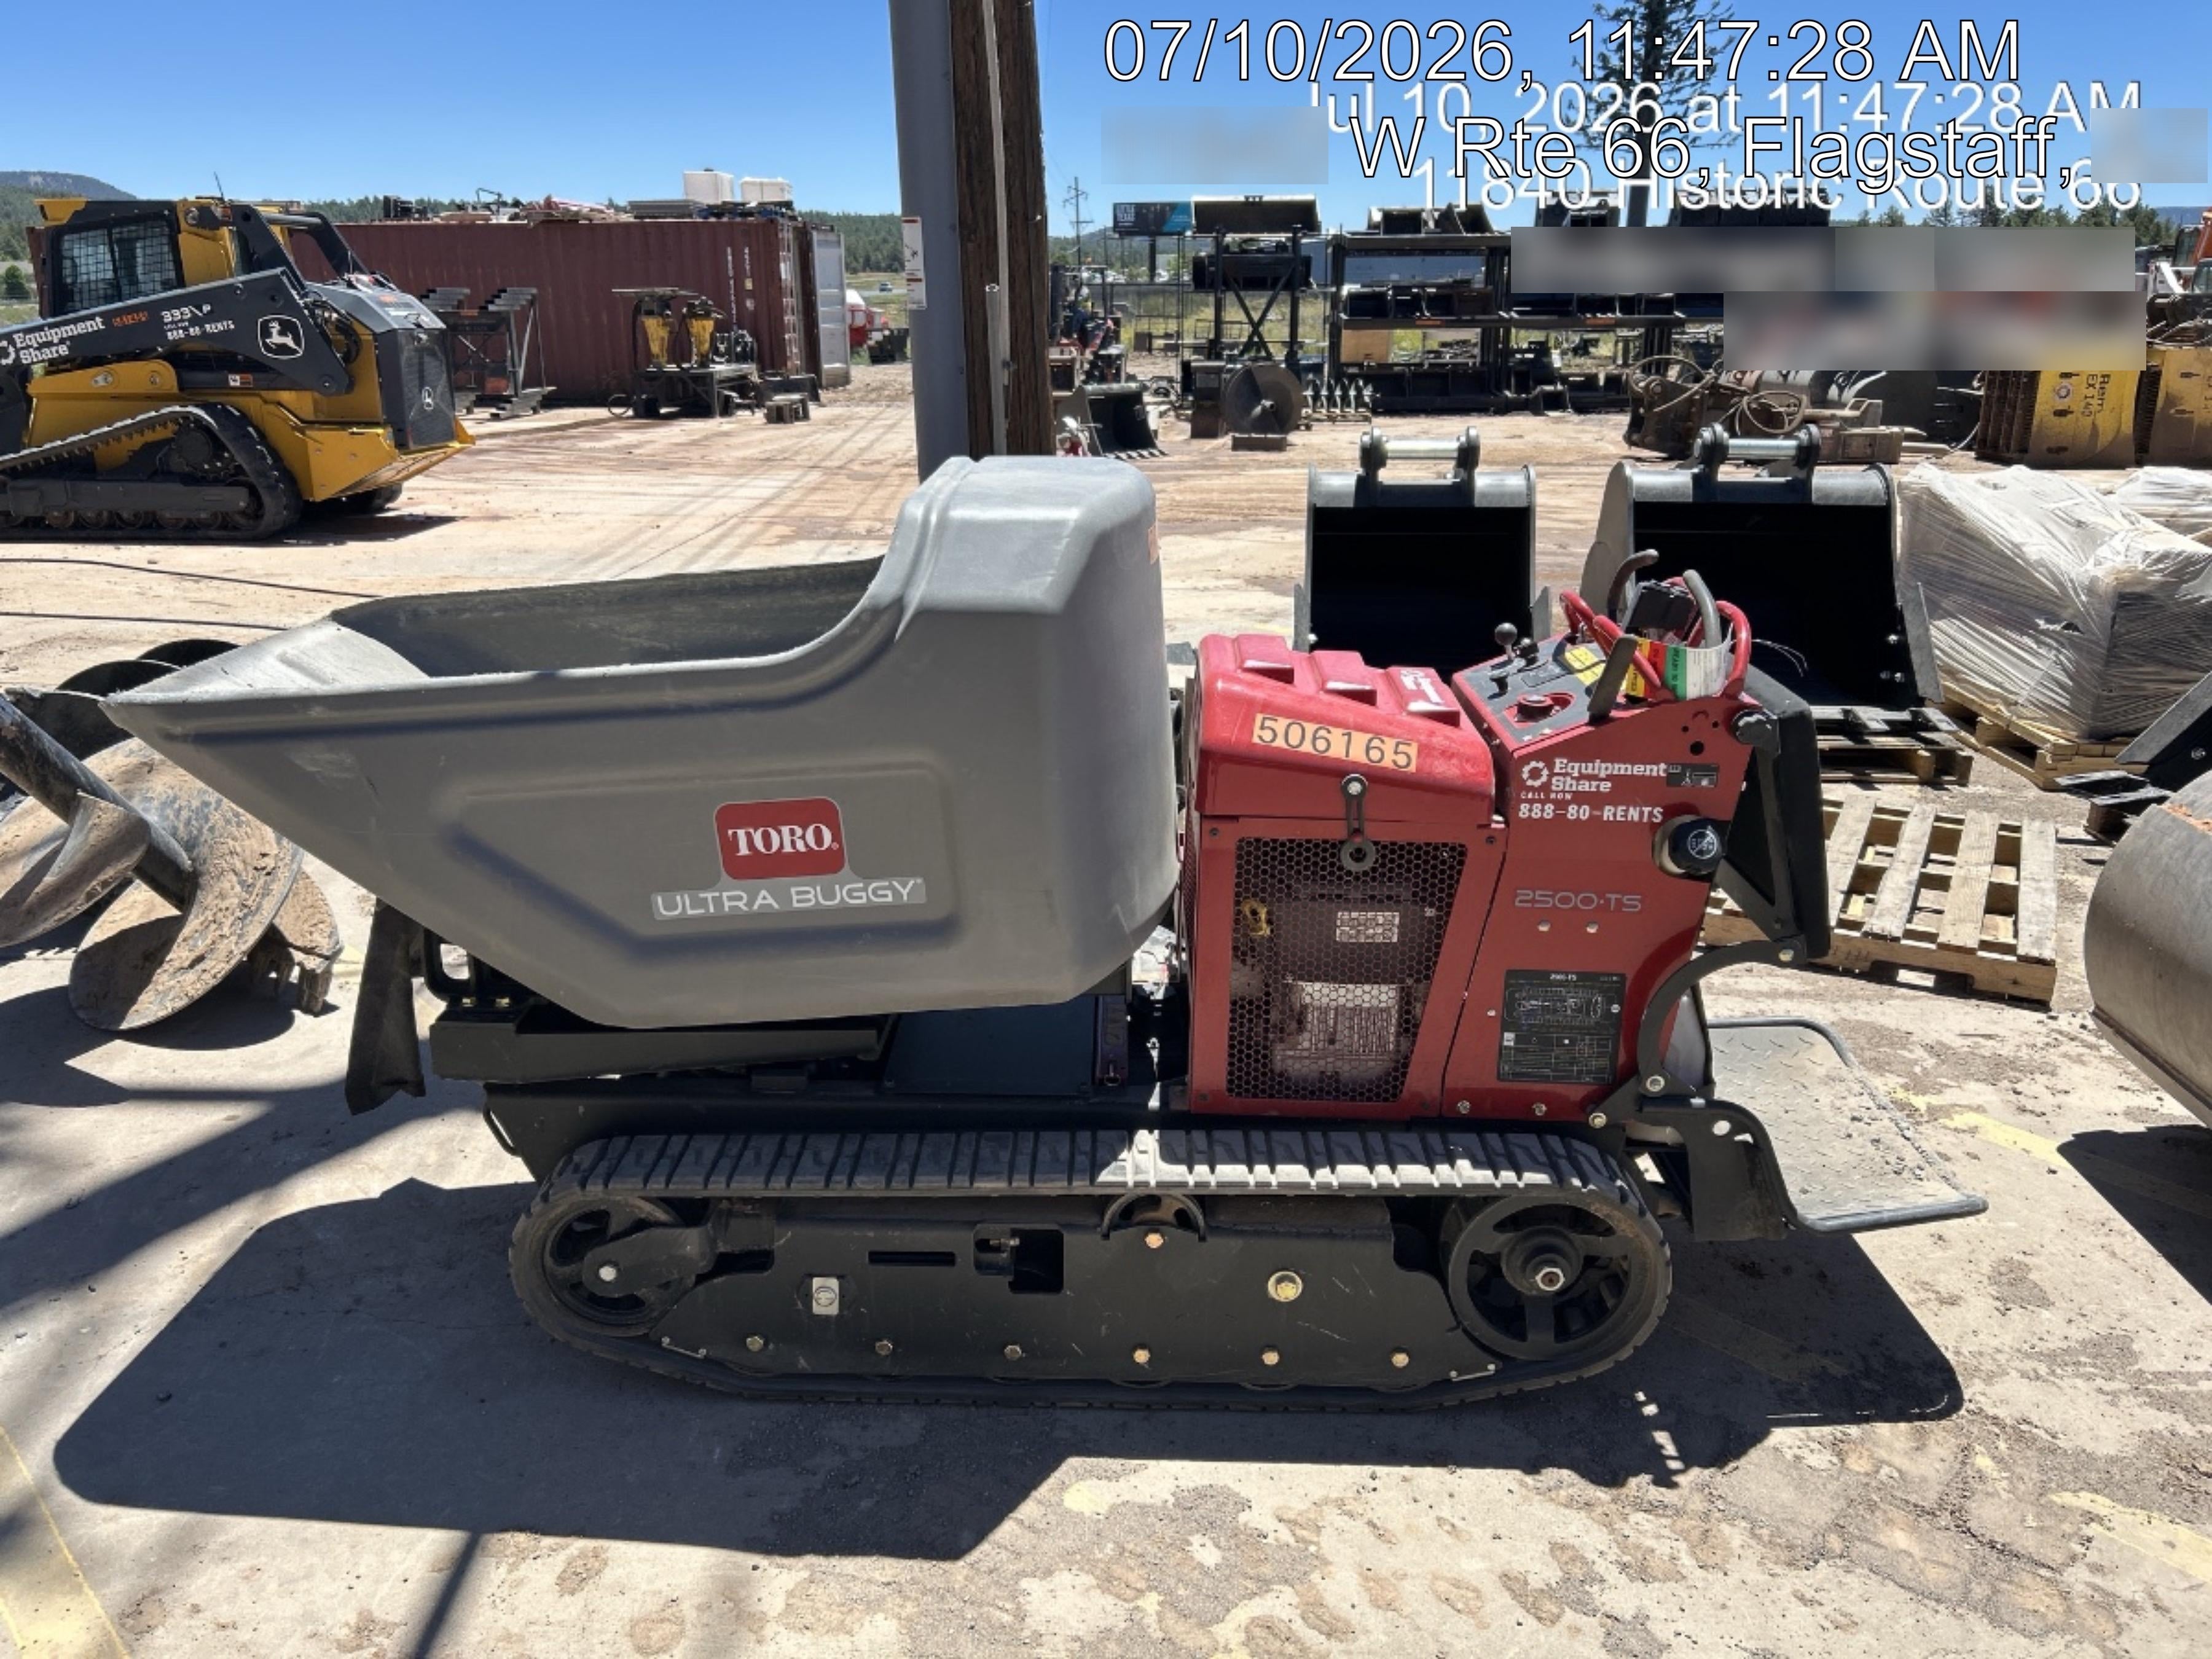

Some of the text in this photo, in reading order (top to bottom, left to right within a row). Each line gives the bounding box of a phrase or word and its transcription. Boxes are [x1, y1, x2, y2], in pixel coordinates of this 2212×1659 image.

[12, 315, 106, 350] Equipment
[19, 343, 69, 366] Share
[1257, 716, 1413, 770] 506165
[1553, 757, 1667, 777] Equipment
[1550, 775, 1612, 793] Share
[1518, 802, 1664, 823] 888-80-RENTS
[728, 823, 833, 857] TORO
[656, 879, 916, 916] ULTRA BUGGY
